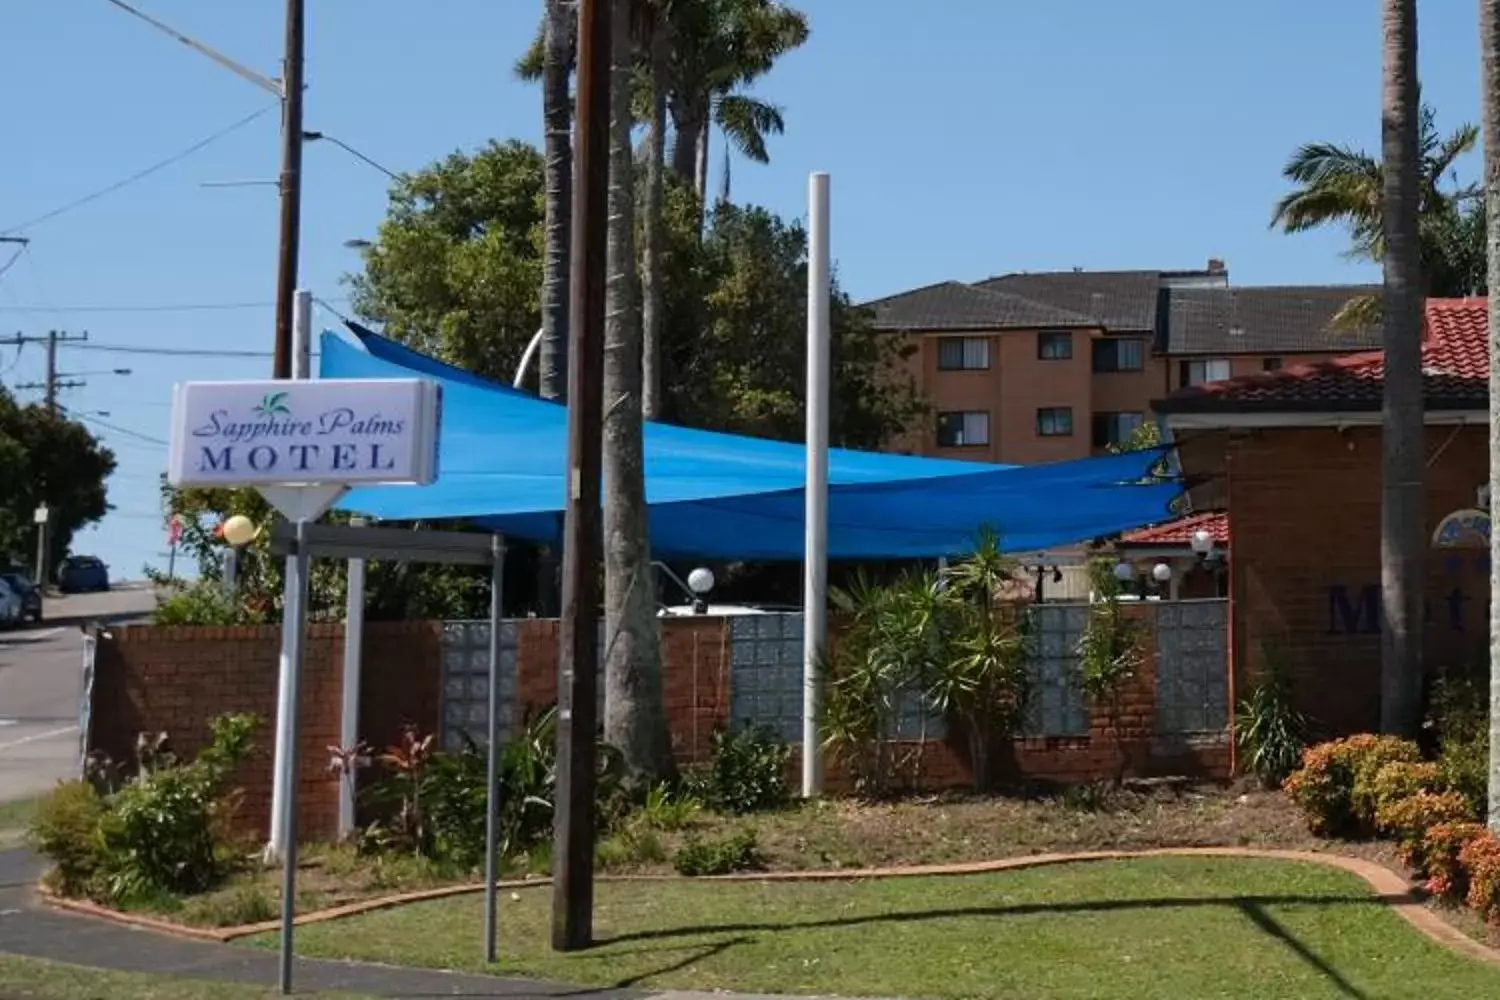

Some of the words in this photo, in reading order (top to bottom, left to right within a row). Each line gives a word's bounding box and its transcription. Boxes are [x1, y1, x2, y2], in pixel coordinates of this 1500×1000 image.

[192, 408, 311, 444] Sapphire
[317, 407, 405, 436] Palms
[199, 443, 395, 473] MOTEL
